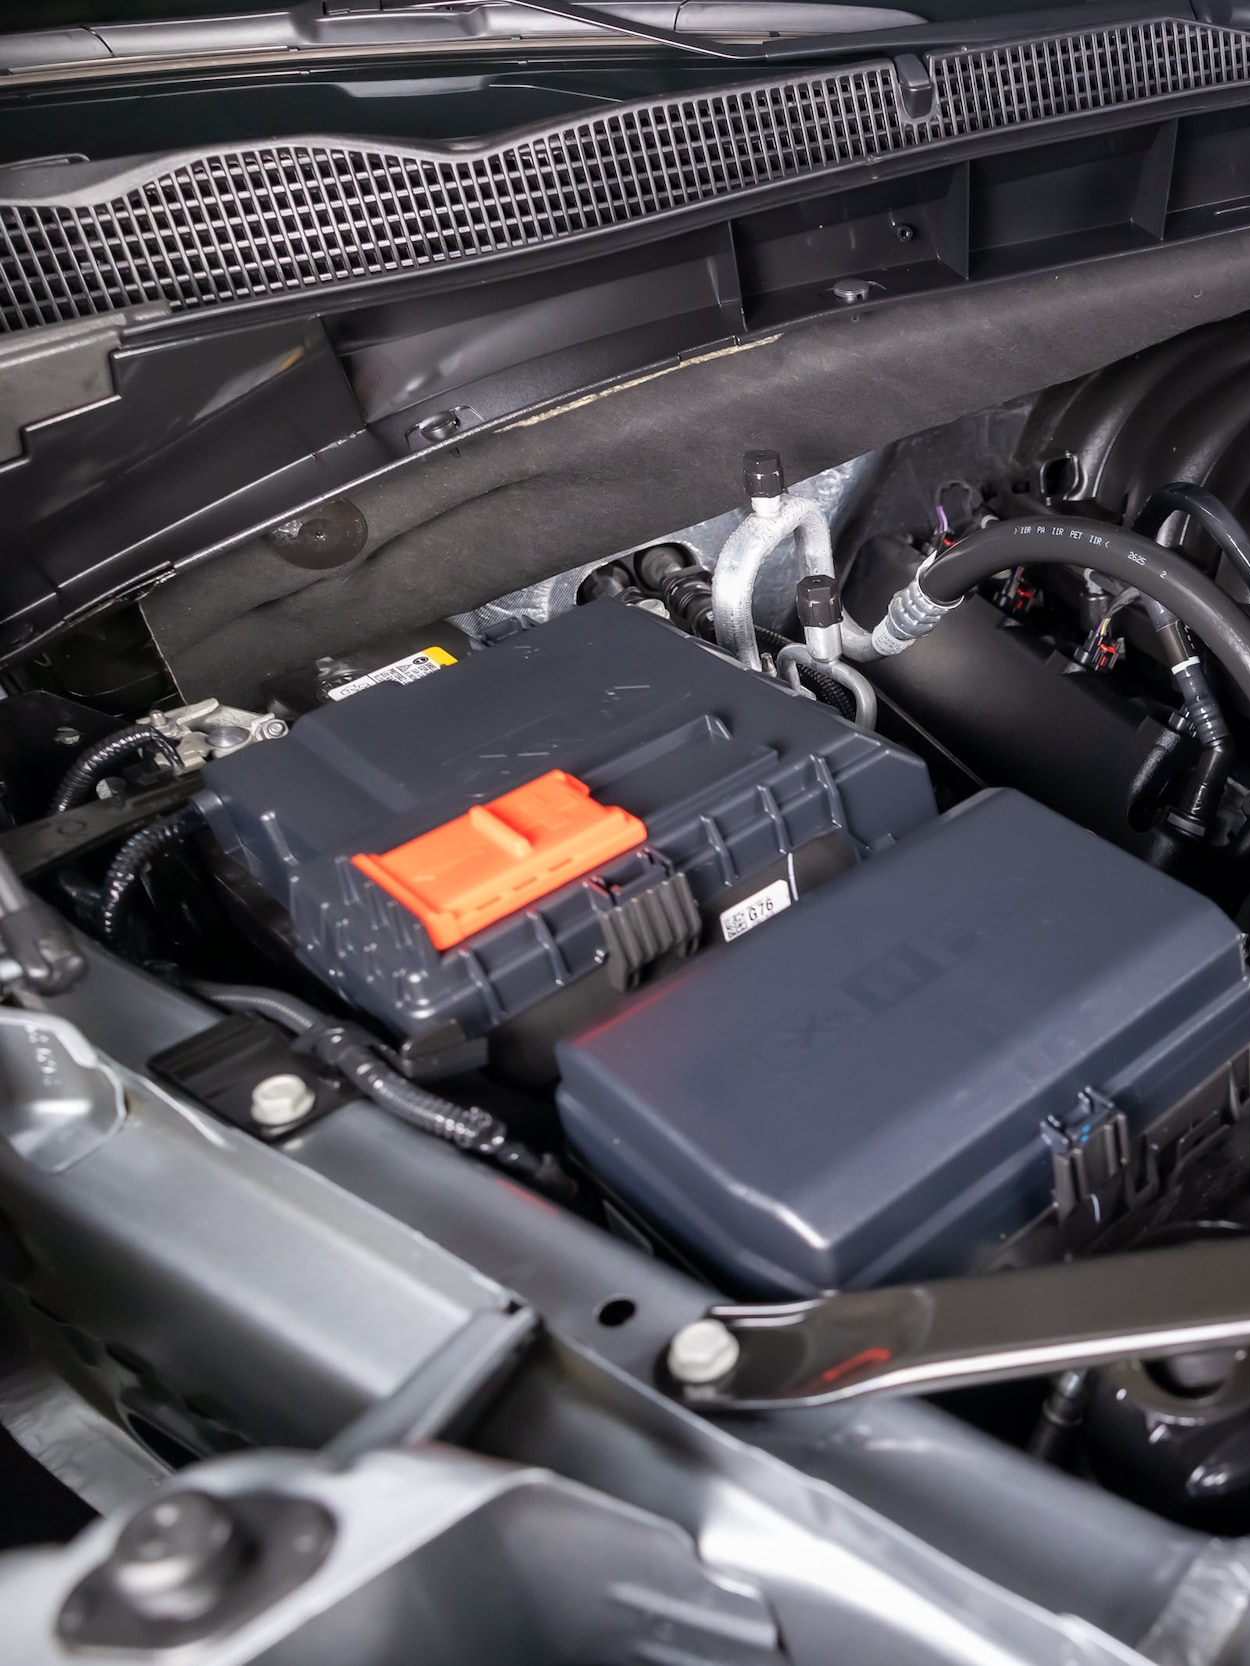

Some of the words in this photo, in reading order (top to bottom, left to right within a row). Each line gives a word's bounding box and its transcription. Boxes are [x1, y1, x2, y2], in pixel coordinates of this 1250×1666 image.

[1036, 526, 1046, 534] PA
[1069, 530, 1083, 540] PET
[1159, 570, 1168, 579] 2
[748, 898, 774, 921] G76
